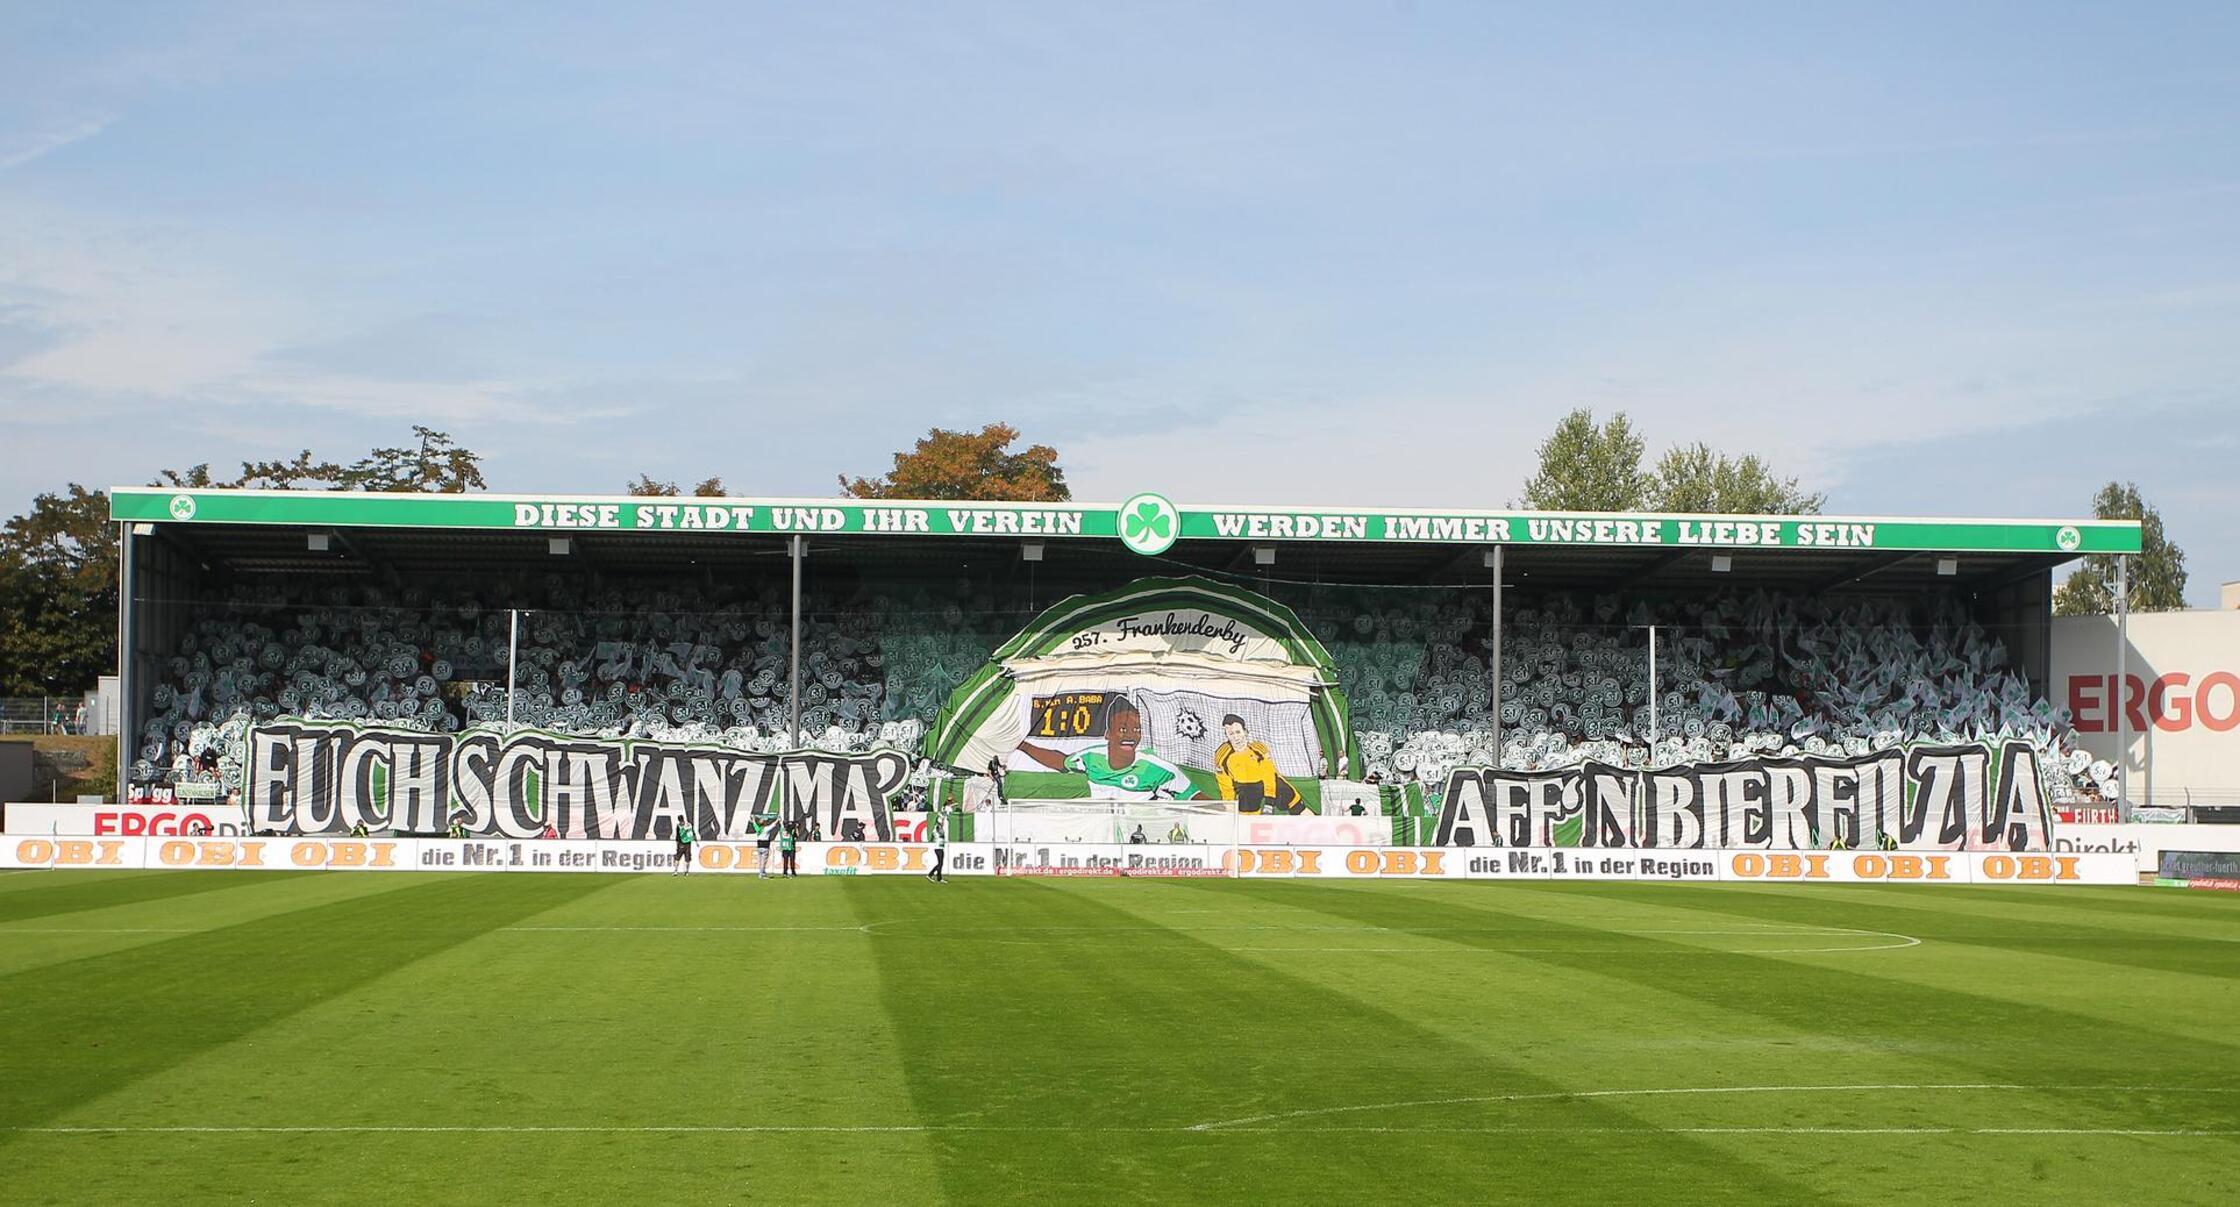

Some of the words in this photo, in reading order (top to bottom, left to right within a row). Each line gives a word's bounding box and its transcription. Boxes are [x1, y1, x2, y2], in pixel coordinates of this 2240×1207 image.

[514, 502, 619, 528] DIESE
[637, 505, 754, 530] STADT
[770, 506, 846, 531] UND
[862, 508, 931, 533] IHR
[948, 509, 1083, 535] VEREIN
[1212, 513, 1368, 539] WERDEN
[1384, 516, 1512, 541] IMMER
[1527, 517, 1662, 543] UNSERE
[1677, 520, 1781, 545] LIEBE
[1796, 522, 1876, 547] SEIN
[1072, 631, 1107, 649] 257.
[1116, 612, 1246, 653] Frankenderby
[2068, 671, 2240, 732] ERGO
[1040, 706, 1091, 735] 1:0
[252, 730, 441, 833] EUCH
[451, 741, 766, 841] SCHWANZ
[16, 839, 124, 864] OBI
[159, 840, 267, 866] OBI
[291, 842, 397, 867] OBI
[421, 847, 455, 866] die
[532, 848, 551, 866] in
[558, 849, 596, 867] der
[826, 846, 928, 870] OBI
[952, 852, 985, 870] die
[1060, 853, 1078, 868] in
[1086, 853, 1122, 868] der
[1222, 849, 1322, 873] OBI
[1346, 850, 1446, 875] OBI
[1469, 856, 1501, 873] die
[1575, 856, 1593, 874] in
[1600, 857, 1635, 875] der
[1641, 857, 1714, 878] Region
[1732, 853, 1830, 878] OBI
[1853, 855, 1951, 879] OBI
[1982, 856, 2081, 880] OBI
